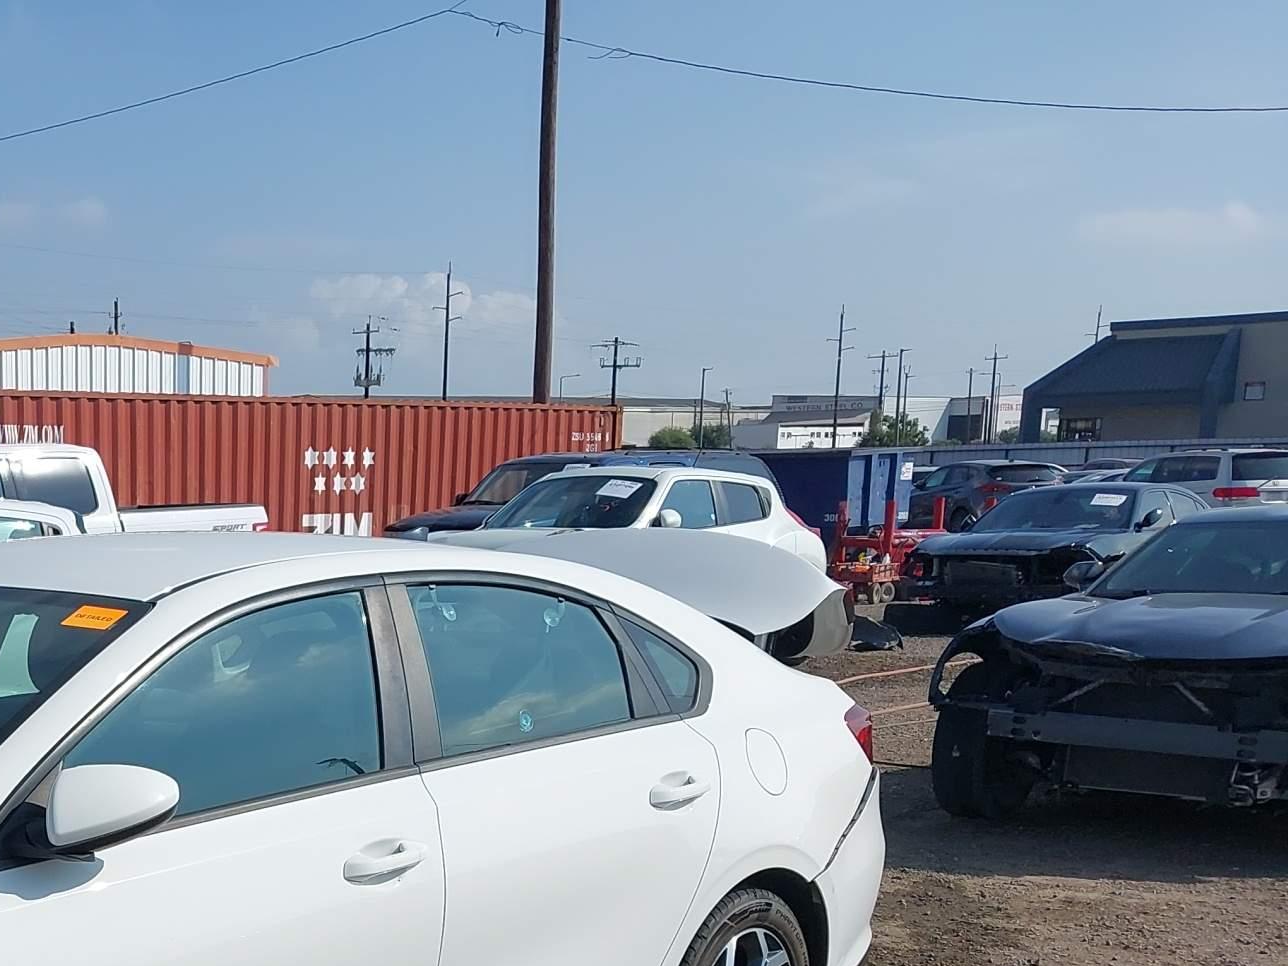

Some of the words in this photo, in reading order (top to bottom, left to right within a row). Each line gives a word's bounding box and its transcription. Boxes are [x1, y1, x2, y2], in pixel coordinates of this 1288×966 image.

[212, 523, 247, 532] SPORT
[302, 512, 373, 537] ZIM
[74, 613, 113, 622] DETAILED
